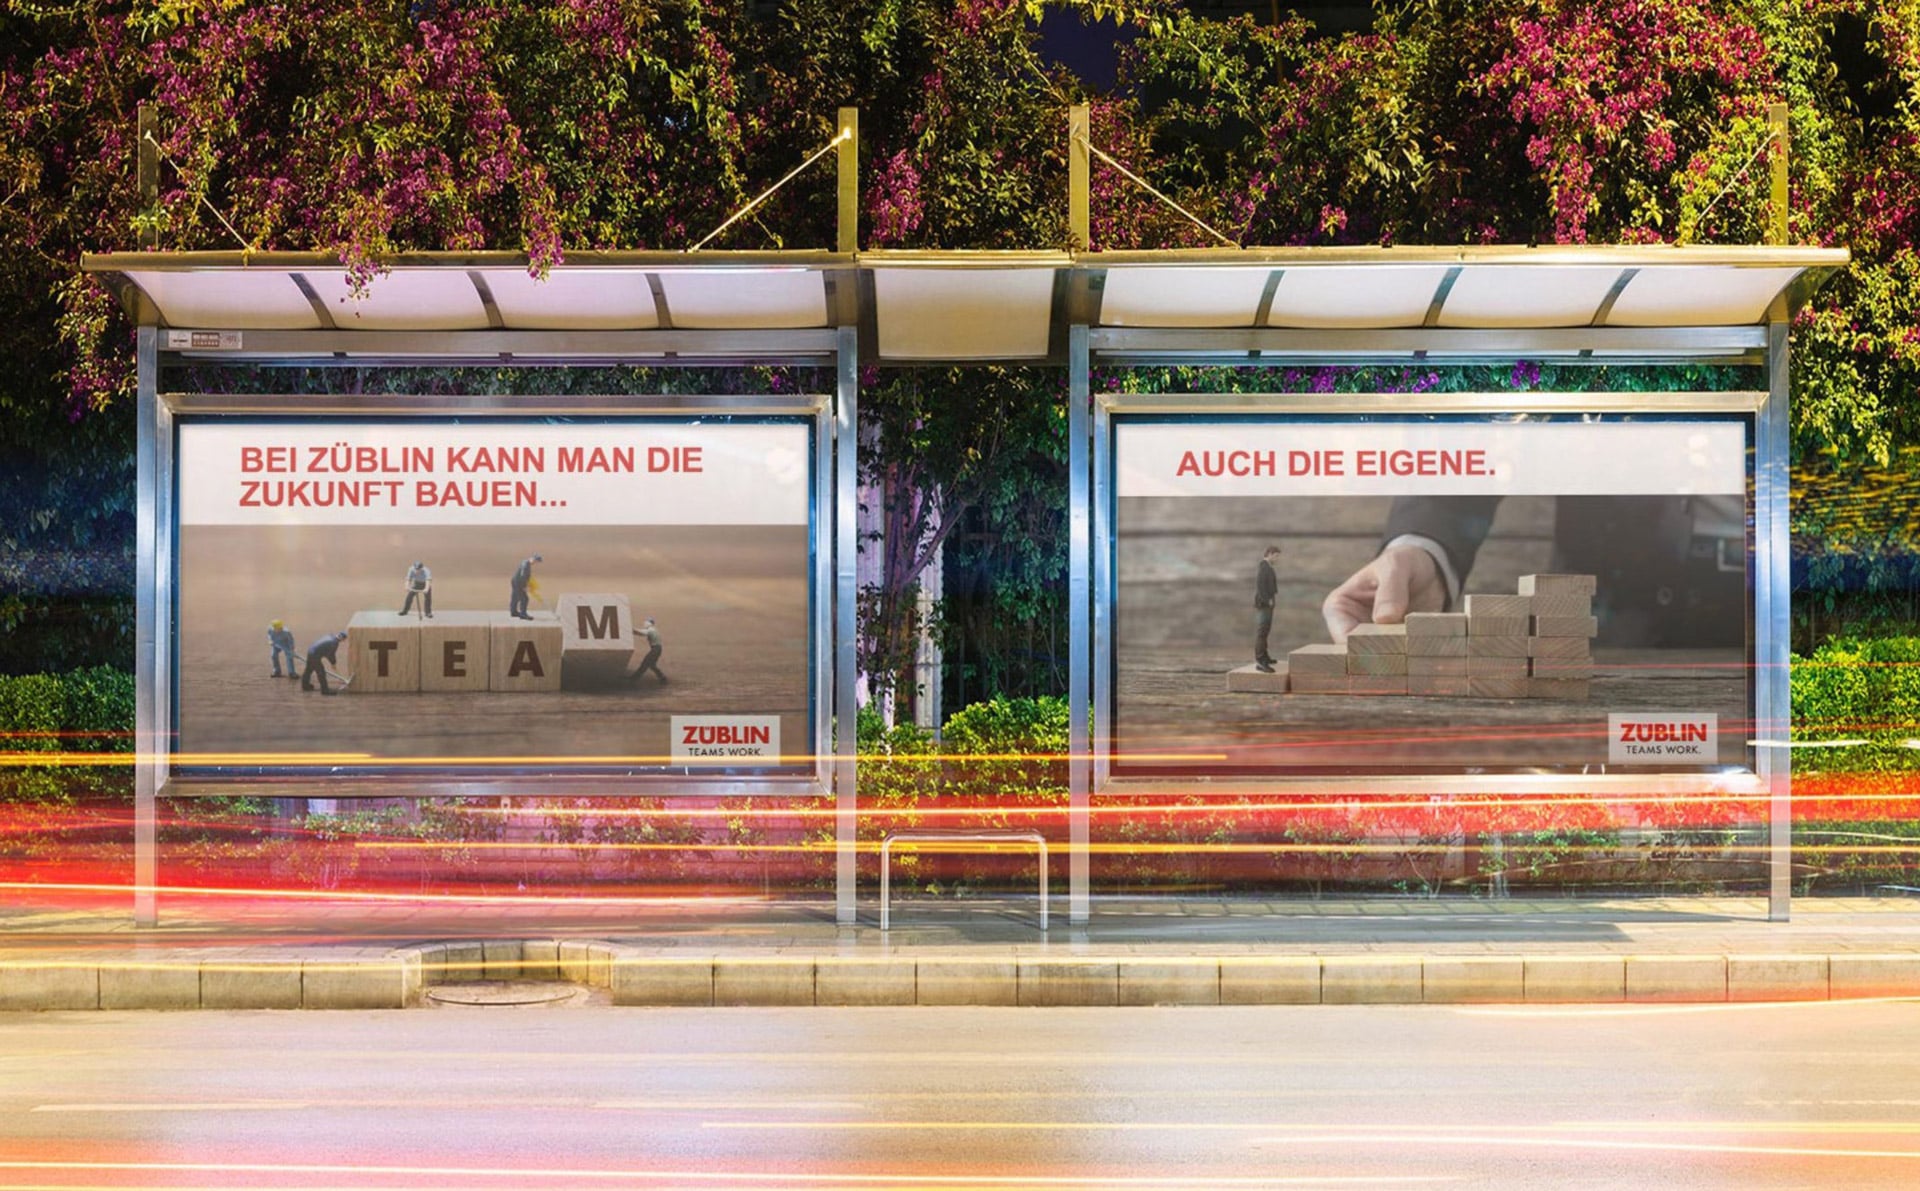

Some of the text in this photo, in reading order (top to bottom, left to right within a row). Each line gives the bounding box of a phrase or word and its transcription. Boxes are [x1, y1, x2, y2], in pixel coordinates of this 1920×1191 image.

[241, 443, 702, 473] BEI ZÜBLIN KANN MAN DIE
[1176, 450, 1495, 477] AUCH DIE EIGENE.
[240, 481, 567, 507] ZUKUNFT BAUEN...
[369, 605, 620, 677] TEAM
[682, 725, 770, 744] ZÜBLIN
[1620, 723, 1707, 742] ZÜBLIN
[688, 747, 764, 756] TEAMS WORK.
[1626, 745, 1702, 754] TEAMS WORK.
